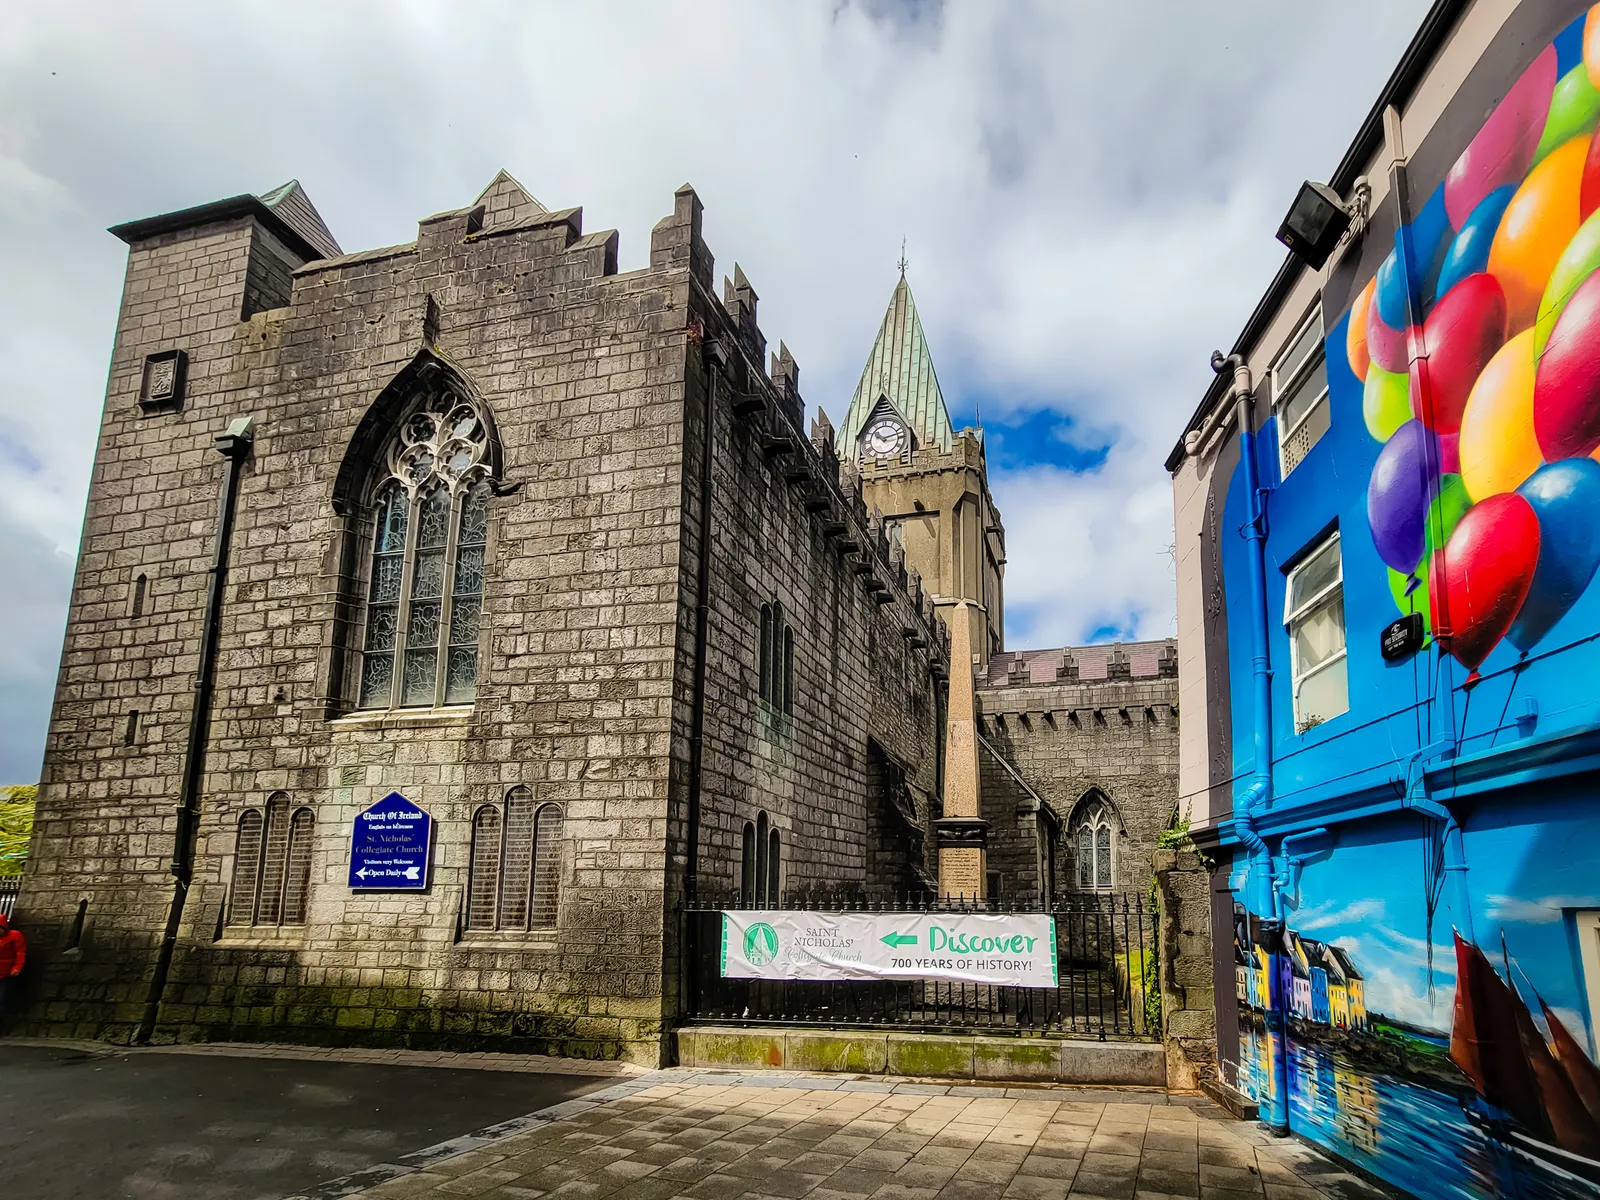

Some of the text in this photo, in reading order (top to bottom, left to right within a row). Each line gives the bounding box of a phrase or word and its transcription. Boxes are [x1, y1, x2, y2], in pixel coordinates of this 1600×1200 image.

[363, 811, 422, 821] Church Of Ireland
[356, 845, 423, 854] Collegiate Church
[386, 869, 402, 877] Daily
[806, 928, 840, 937] SAINT
[929, 926, 1038, 954] Discover
[828, 948, 862, 962] Church
[891, 958, 1032, 971] 700 YEARS OF HISTORY!
